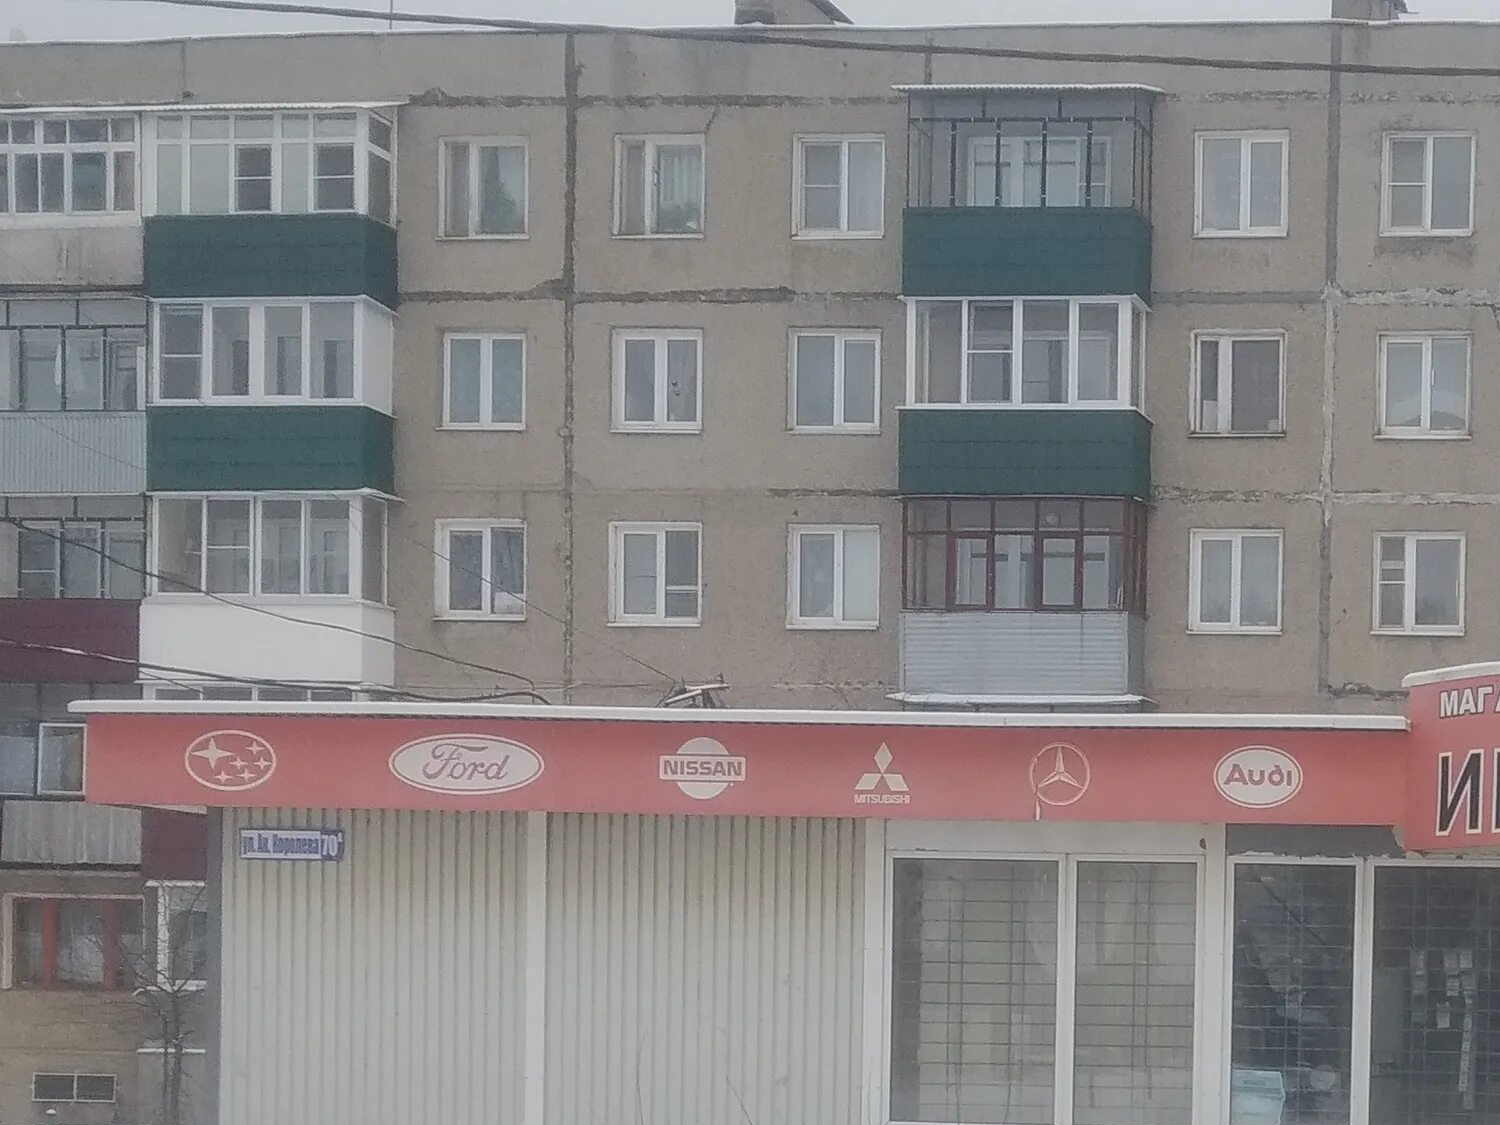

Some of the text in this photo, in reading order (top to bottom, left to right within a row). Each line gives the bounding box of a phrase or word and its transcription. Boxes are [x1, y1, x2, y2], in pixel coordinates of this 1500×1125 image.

[423, 742, 510, 782] Ford
[663, 759, 741, 778] NISSAN
[1224, 763, 1292, 787] Audi
[853, 793, 911, 804] MITSUBISHI
